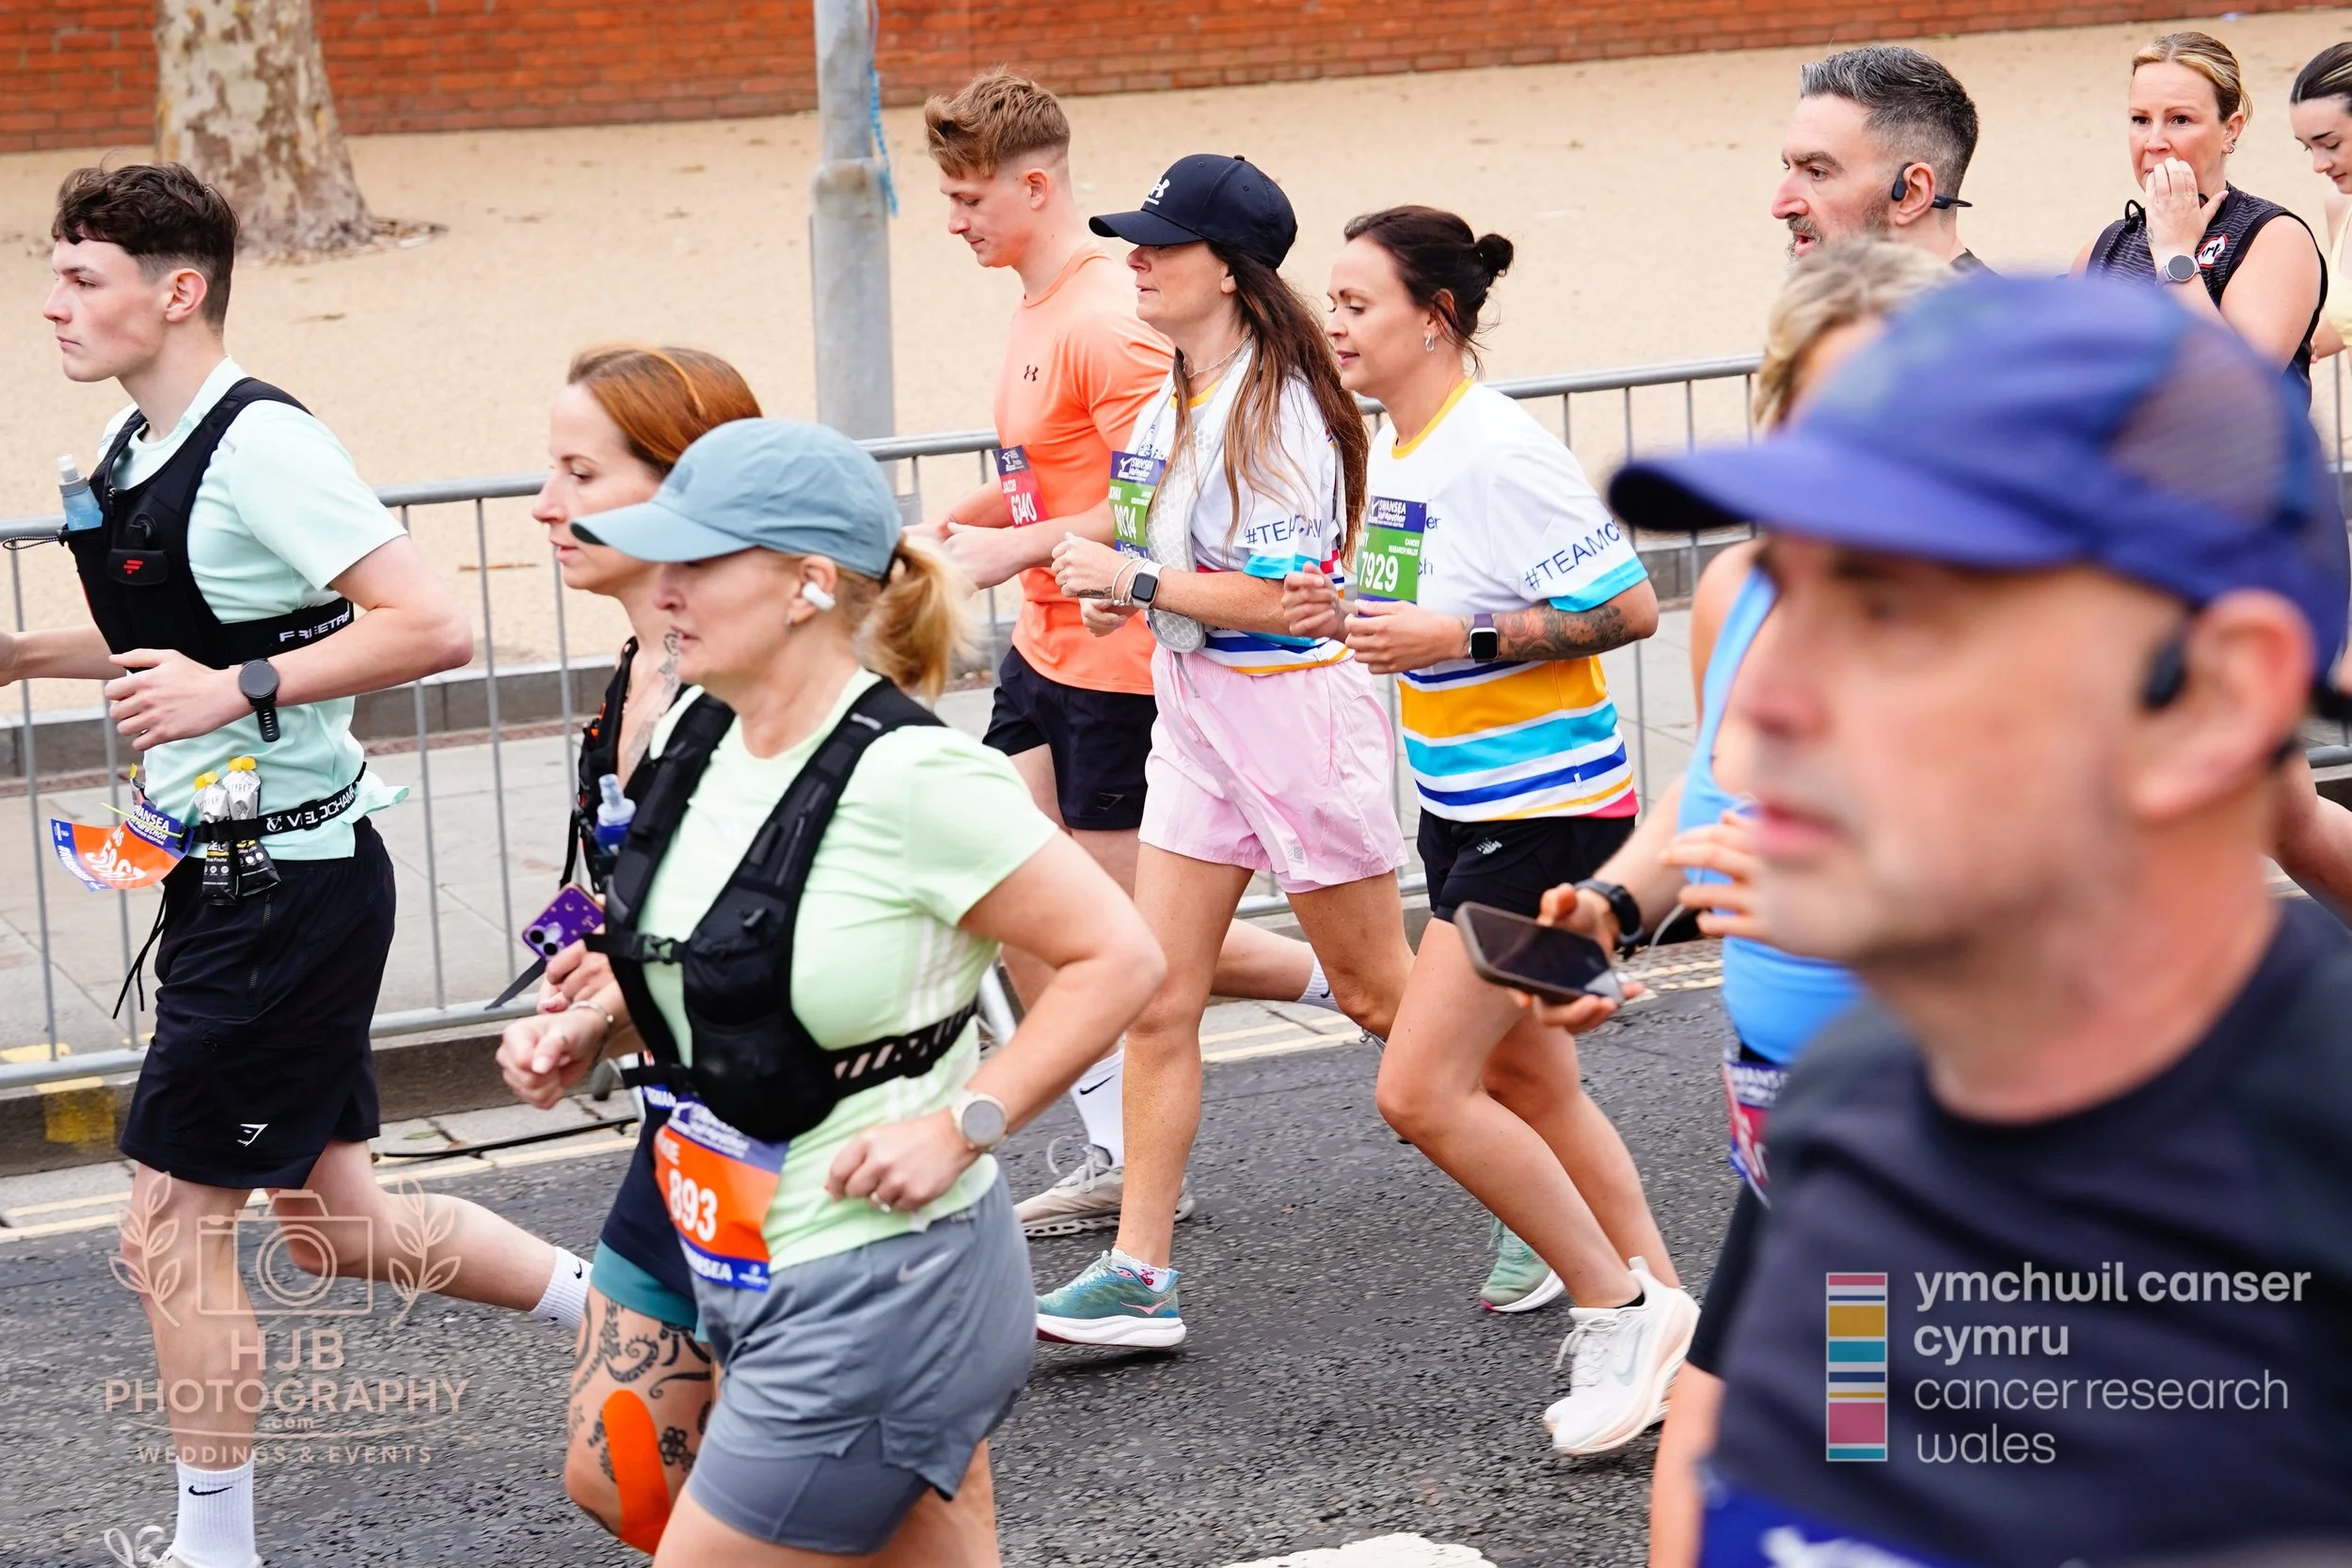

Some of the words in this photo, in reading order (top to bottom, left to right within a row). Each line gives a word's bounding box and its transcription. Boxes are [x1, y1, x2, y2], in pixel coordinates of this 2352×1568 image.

[1010, 491, 1038, 526] 6340
[1378, 499, 1406, 515] SWANSEA
[1359, 551, 1400, 593] 7929
[1525, 519, 1623, 591] #TEAMC
[668, 1168, 718, 1243] 893
